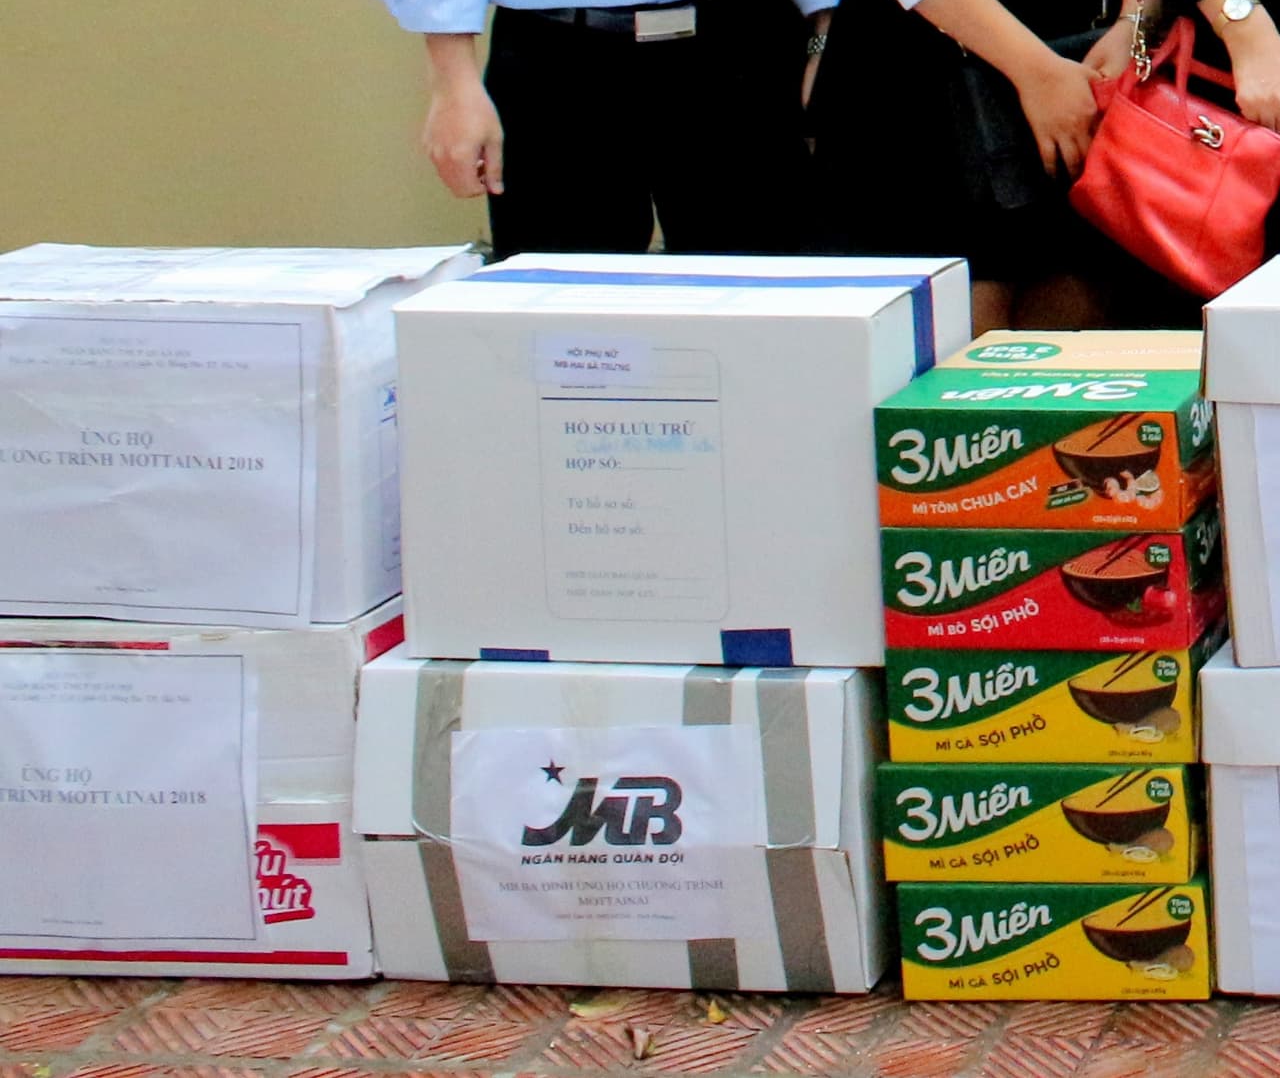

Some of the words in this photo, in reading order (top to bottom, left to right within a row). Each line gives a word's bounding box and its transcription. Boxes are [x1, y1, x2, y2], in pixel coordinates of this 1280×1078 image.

[120, 453, 223, 470] MOTTAINAI
[228, 457, 264, 471] 2018
[912, 502, 927, 514] MÌ
[931, 501, 958, 513] TÔM
[961, 492, 1005, 511] CHUA
[1007, 476, 1039, 499] CAY
[57, 791, 164, 804] MOTTAINAI
[171, 791, 207, 804] 2018
